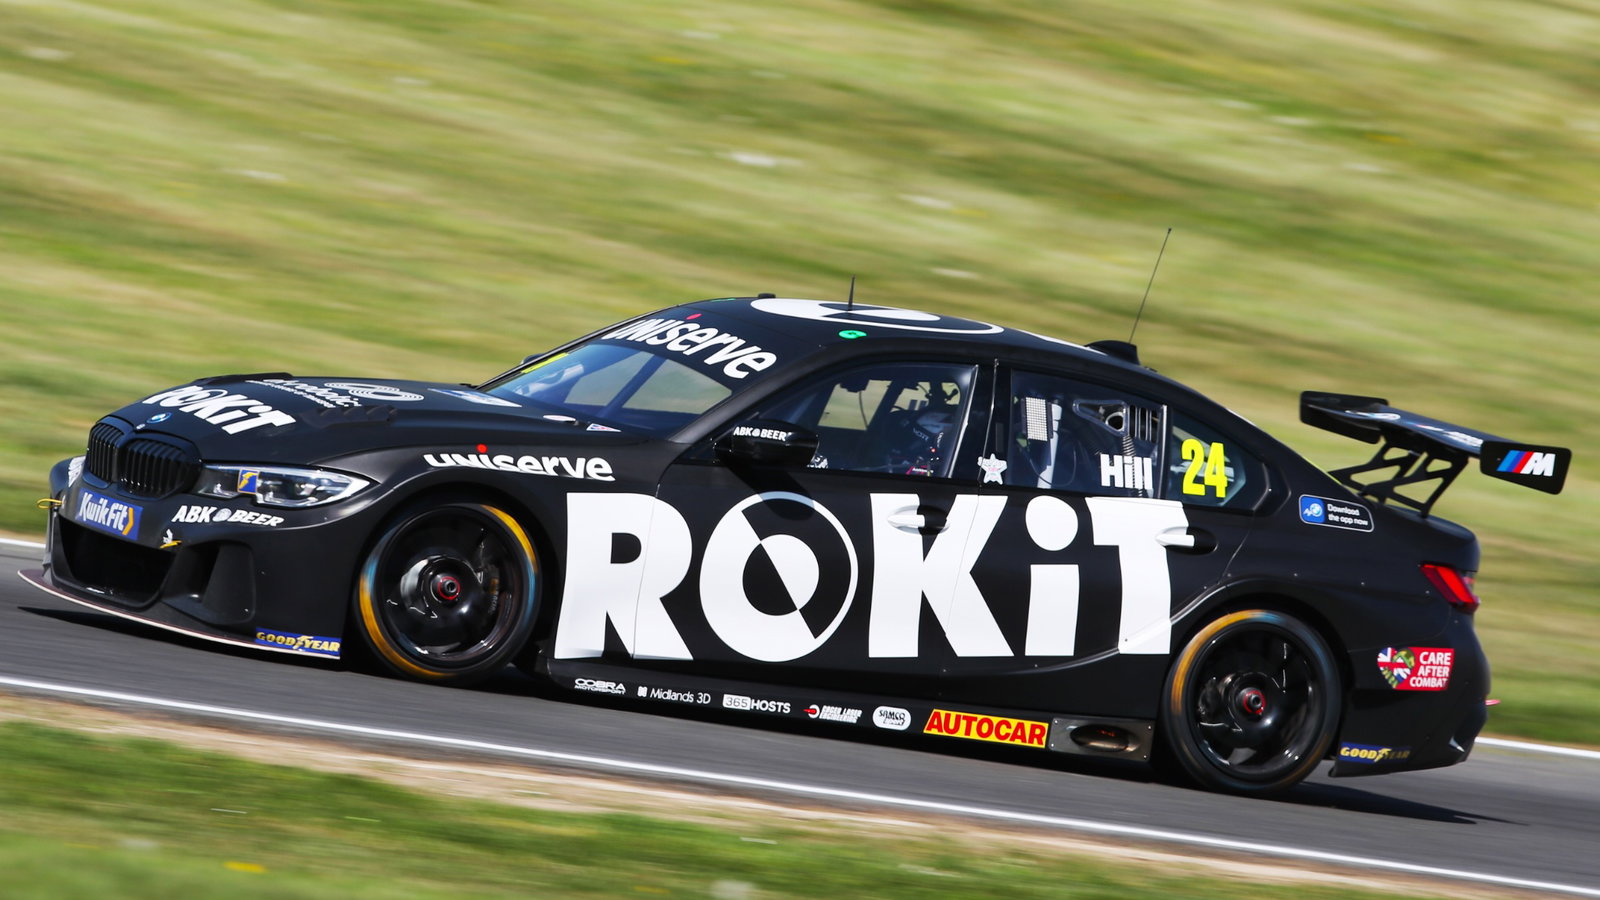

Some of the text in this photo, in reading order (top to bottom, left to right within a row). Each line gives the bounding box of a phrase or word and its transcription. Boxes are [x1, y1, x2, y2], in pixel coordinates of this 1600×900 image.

[733, 426, 786, 441] ABK BEER
[1101, 454, 1153, 490] Hill
[1181, 439, 1228, 498] 24
[171, 505, 285, 527] ABK BEER
[1327, 504, 1360, 516] Download
[1328, 514, 1369, 526] the app now
[256, 632, 340, 652] GOODYEAR
[1419, 651, 1452, 666] CARE
[1417, 665, 1450, 677] AFTER
[574, 678, 626, 691] COBRA
[1409, 677, 1449, 688] COMBAT
[650, 688, 711, 705] Midlands 3D
[926, 711, 1046, 746] AUTOCAR
